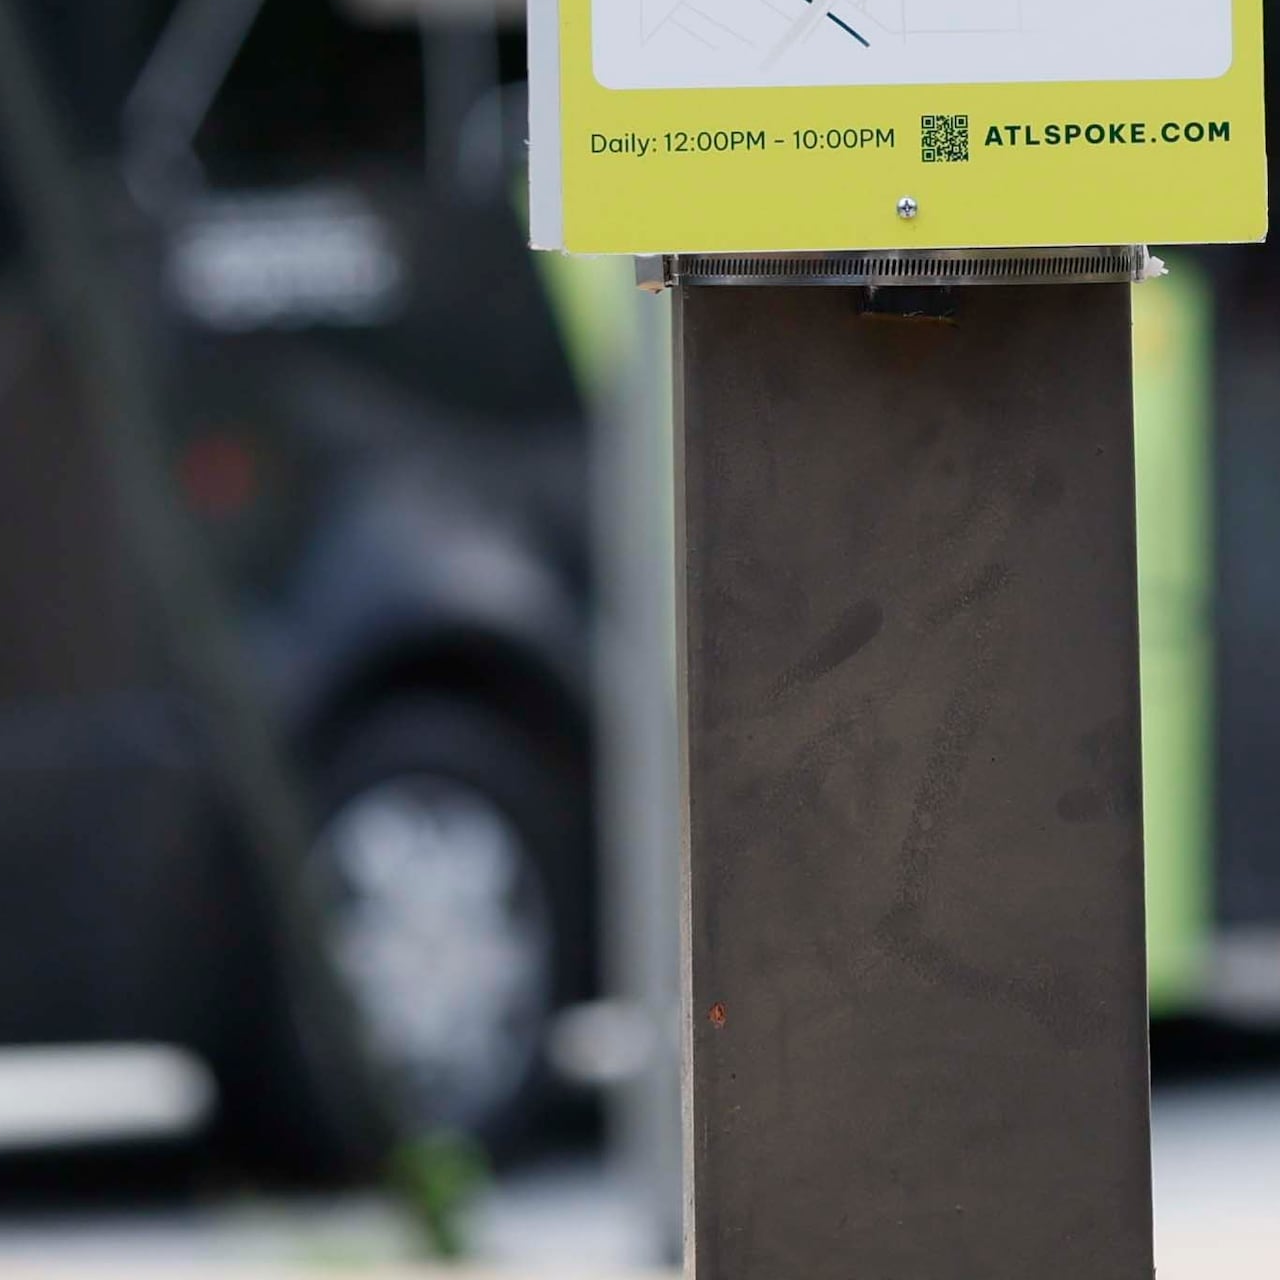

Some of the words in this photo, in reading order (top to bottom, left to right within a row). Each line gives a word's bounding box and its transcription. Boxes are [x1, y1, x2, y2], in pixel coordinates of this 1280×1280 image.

[591, 132, 657, 158] Daily:
[663, 130, 766, 152] 12:00PM
[793, 128, 895, 150] 10:00PM
[984, 121, 1230, 146] ATLSPOKE.COM
